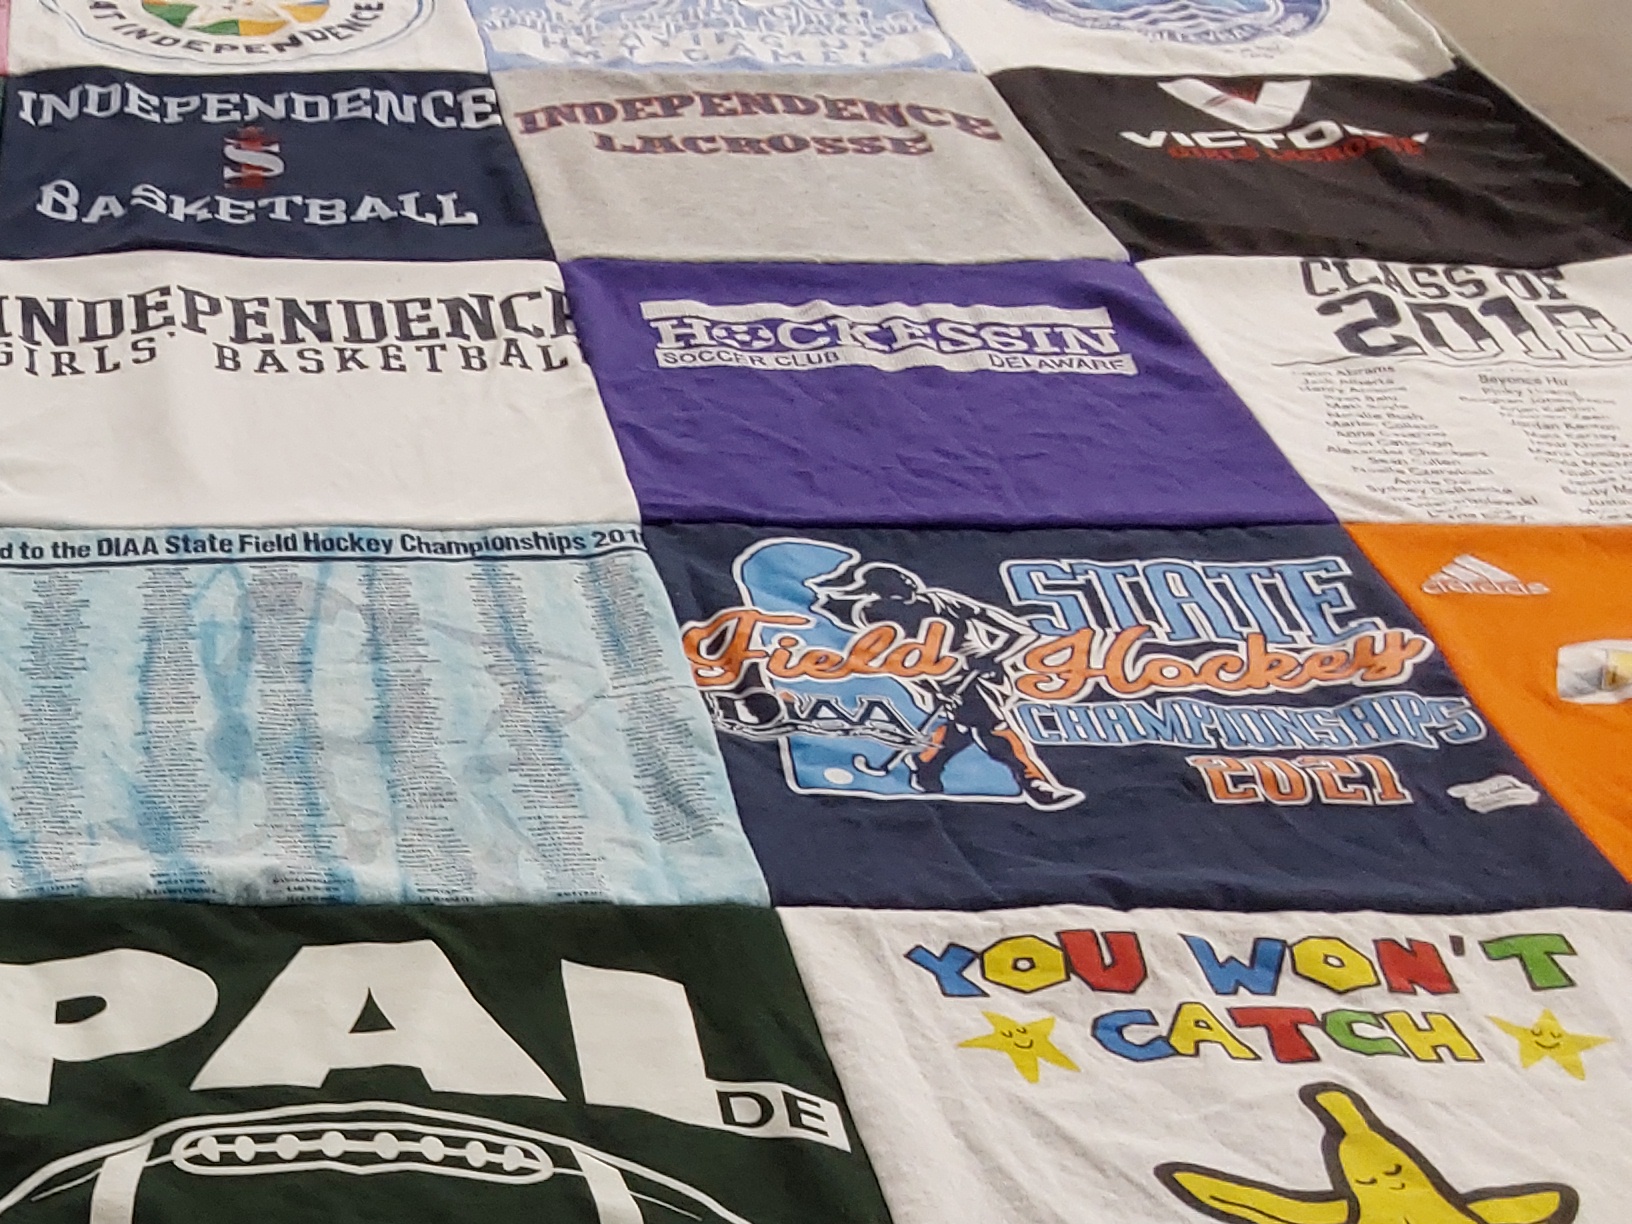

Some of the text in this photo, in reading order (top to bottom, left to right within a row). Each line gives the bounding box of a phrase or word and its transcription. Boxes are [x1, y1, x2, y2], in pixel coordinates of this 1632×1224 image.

[17, 82, 503, 129] INDEPENDENCE
[514, 90, 1002, 141] INDEPENDENCE
[594, 131, 933, 155] LACROSSE
[1120, 120, 1429, 150] VICTO
[36, 179, 478, 226] BASKETBALL
[1299, 258, 1569, 301] CLASS OF
[649, 316, 1122, 354] HOCKESSIN
[1316, 290, 1632, 362] 2018
[663, 351, 840, 367] SOCCER CLUB
[988, 354, 1126, 372] DELAWARE
[20, 540, 45, 559] to
[51, 540, 91, 559] the
[97, 537, 160, 558] DIAA
[164, 534, 233, 555] State
[238, 532, 298, 553] Field
[303, 531, 394, 556] Hockey
[400, 530, 586, 557] Championships
[590, 528, 645, 549] 201
[1000, 557, 1356, 646] STATE
[679, 605, 1435, 703] Field Hockey
[1007, 692, 1486, 749] CHAMPIONSHIPS
[1185, 755, 1413, 805] 2021
[905, 930, 1578, 997] YOU WON'T
[1091, 1001, 1484, 1063] CATCH
[719, 1090, 832, 1137] DE
